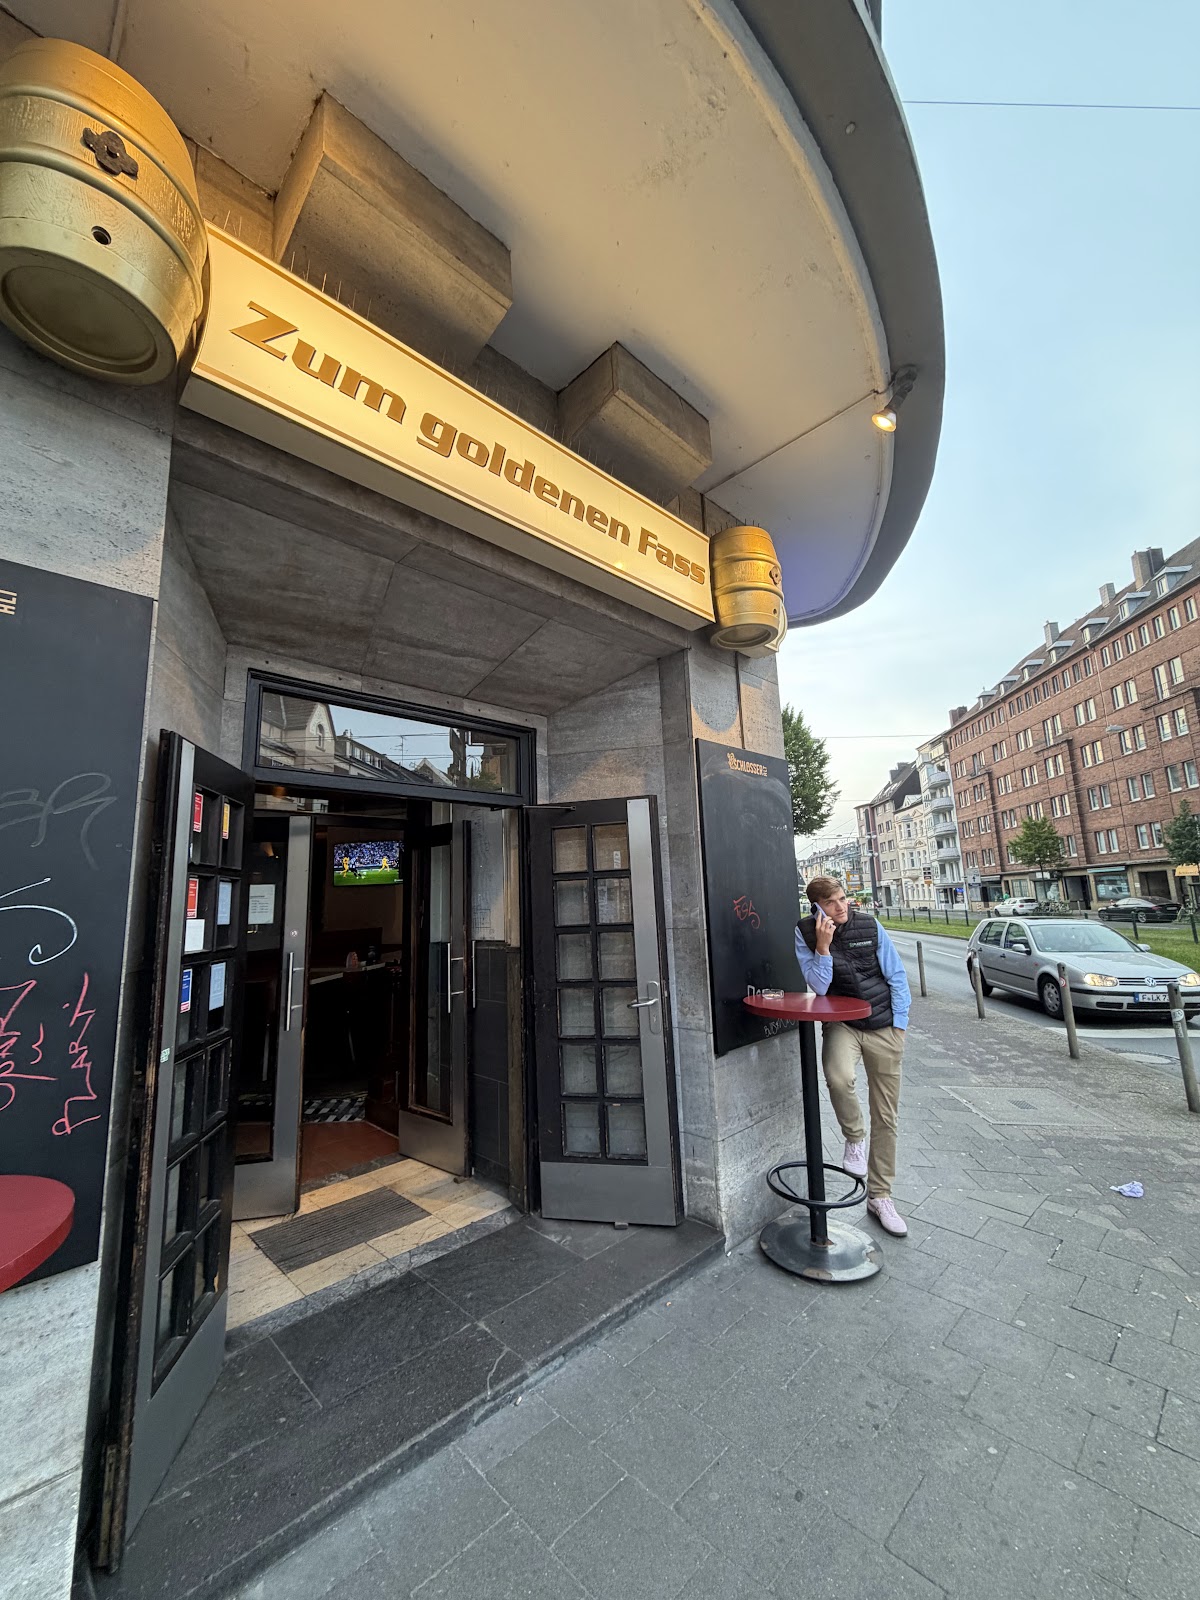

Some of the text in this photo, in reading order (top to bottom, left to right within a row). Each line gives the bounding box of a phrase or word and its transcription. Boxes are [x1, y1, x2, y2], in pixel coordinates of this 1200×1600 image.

[229, 300, 706, 585] Zum goldenen Fass
